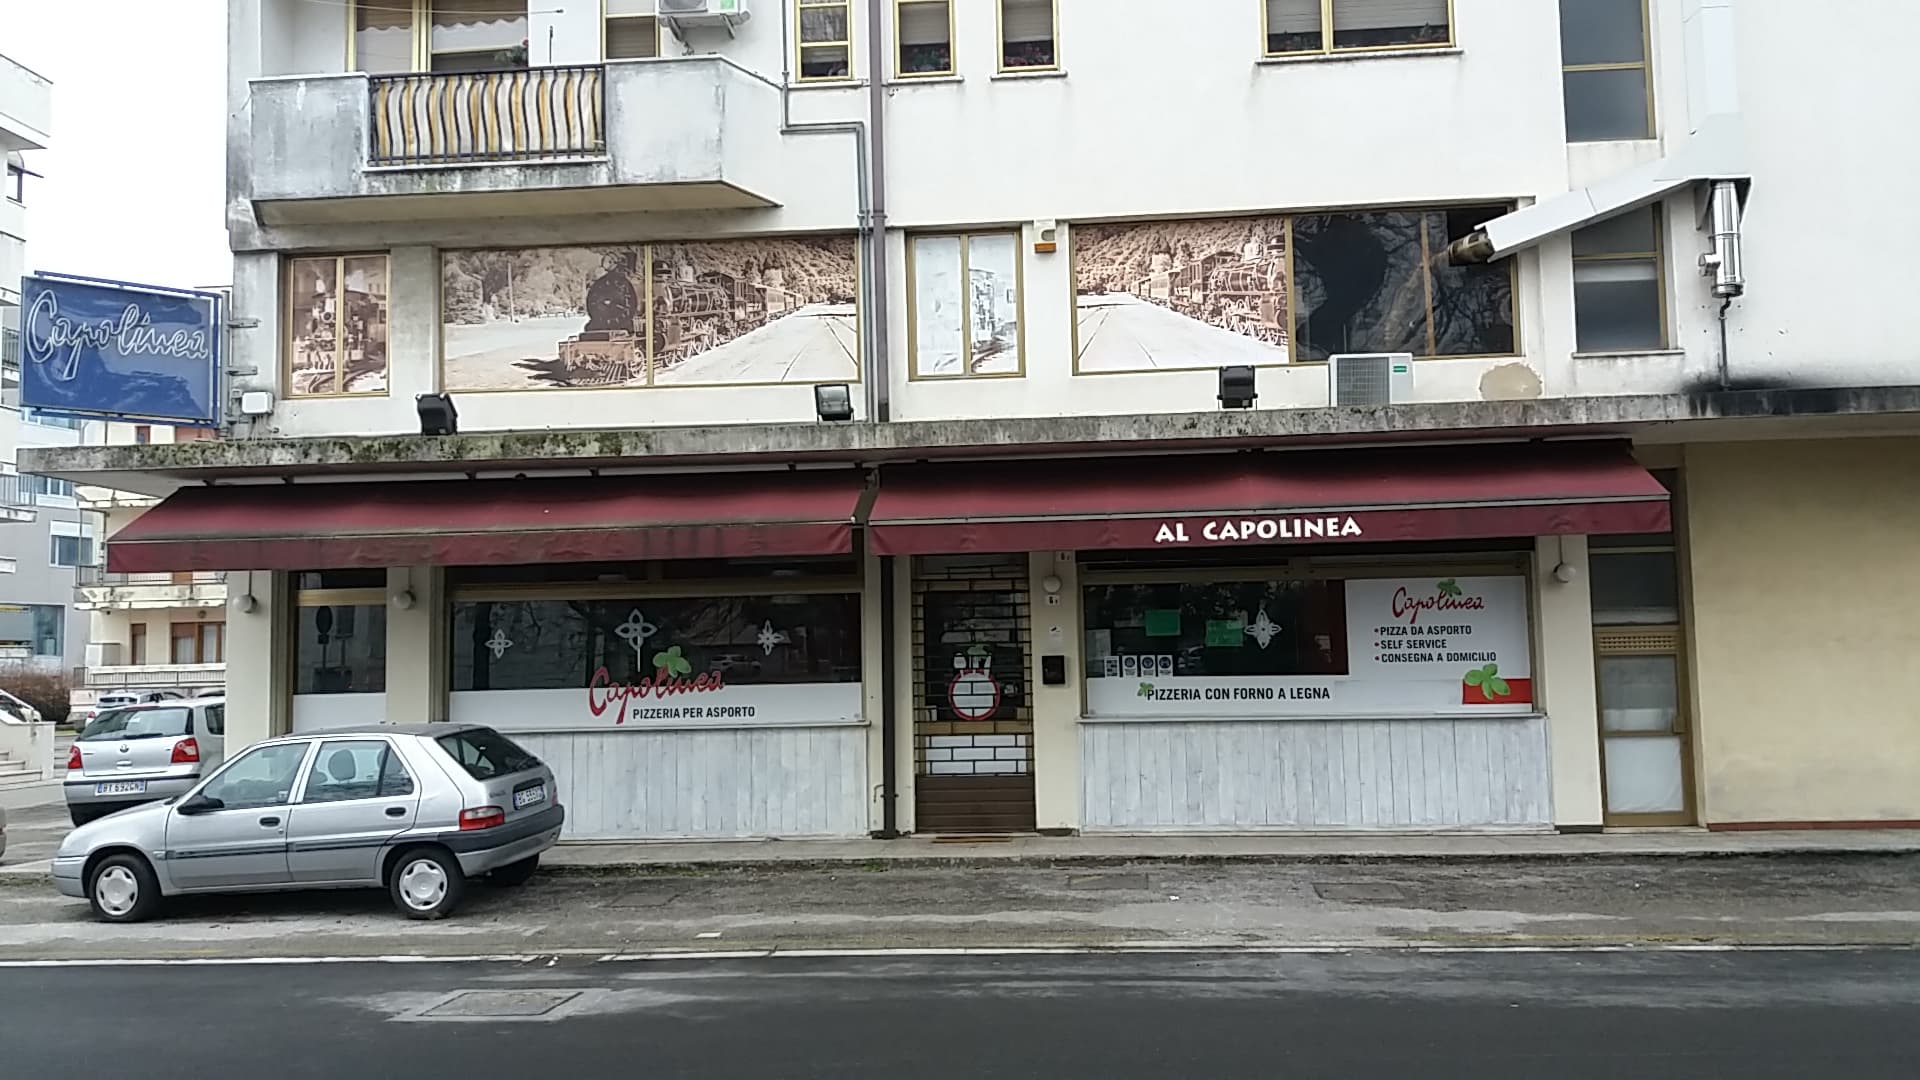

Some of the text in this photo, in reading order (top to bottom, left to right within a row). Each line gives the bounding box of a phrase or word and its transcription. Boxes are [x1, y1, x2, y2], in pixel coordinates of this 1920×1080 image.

[27, 289, 208, 380] Capolinea
[1154, 516, 1362, 543] AL CAPOLINEA
[1392, 586, 1485, 624] Capolinea
[1380, 625, 1472, 636] PIZZA DA ASPORTO
[1381, 638, 1447, 649] SELF SERVICE
[1381, 651, 1497, 663] CONSEGNA A DOMICILIO
[589, 666, 725, 724] Capolinea
[1147, 687, 1330, 700] PIZZERIA CON FORNO A LEGNA
[632, 706, 755, 719] PIZZERIA PER ASPORTO
